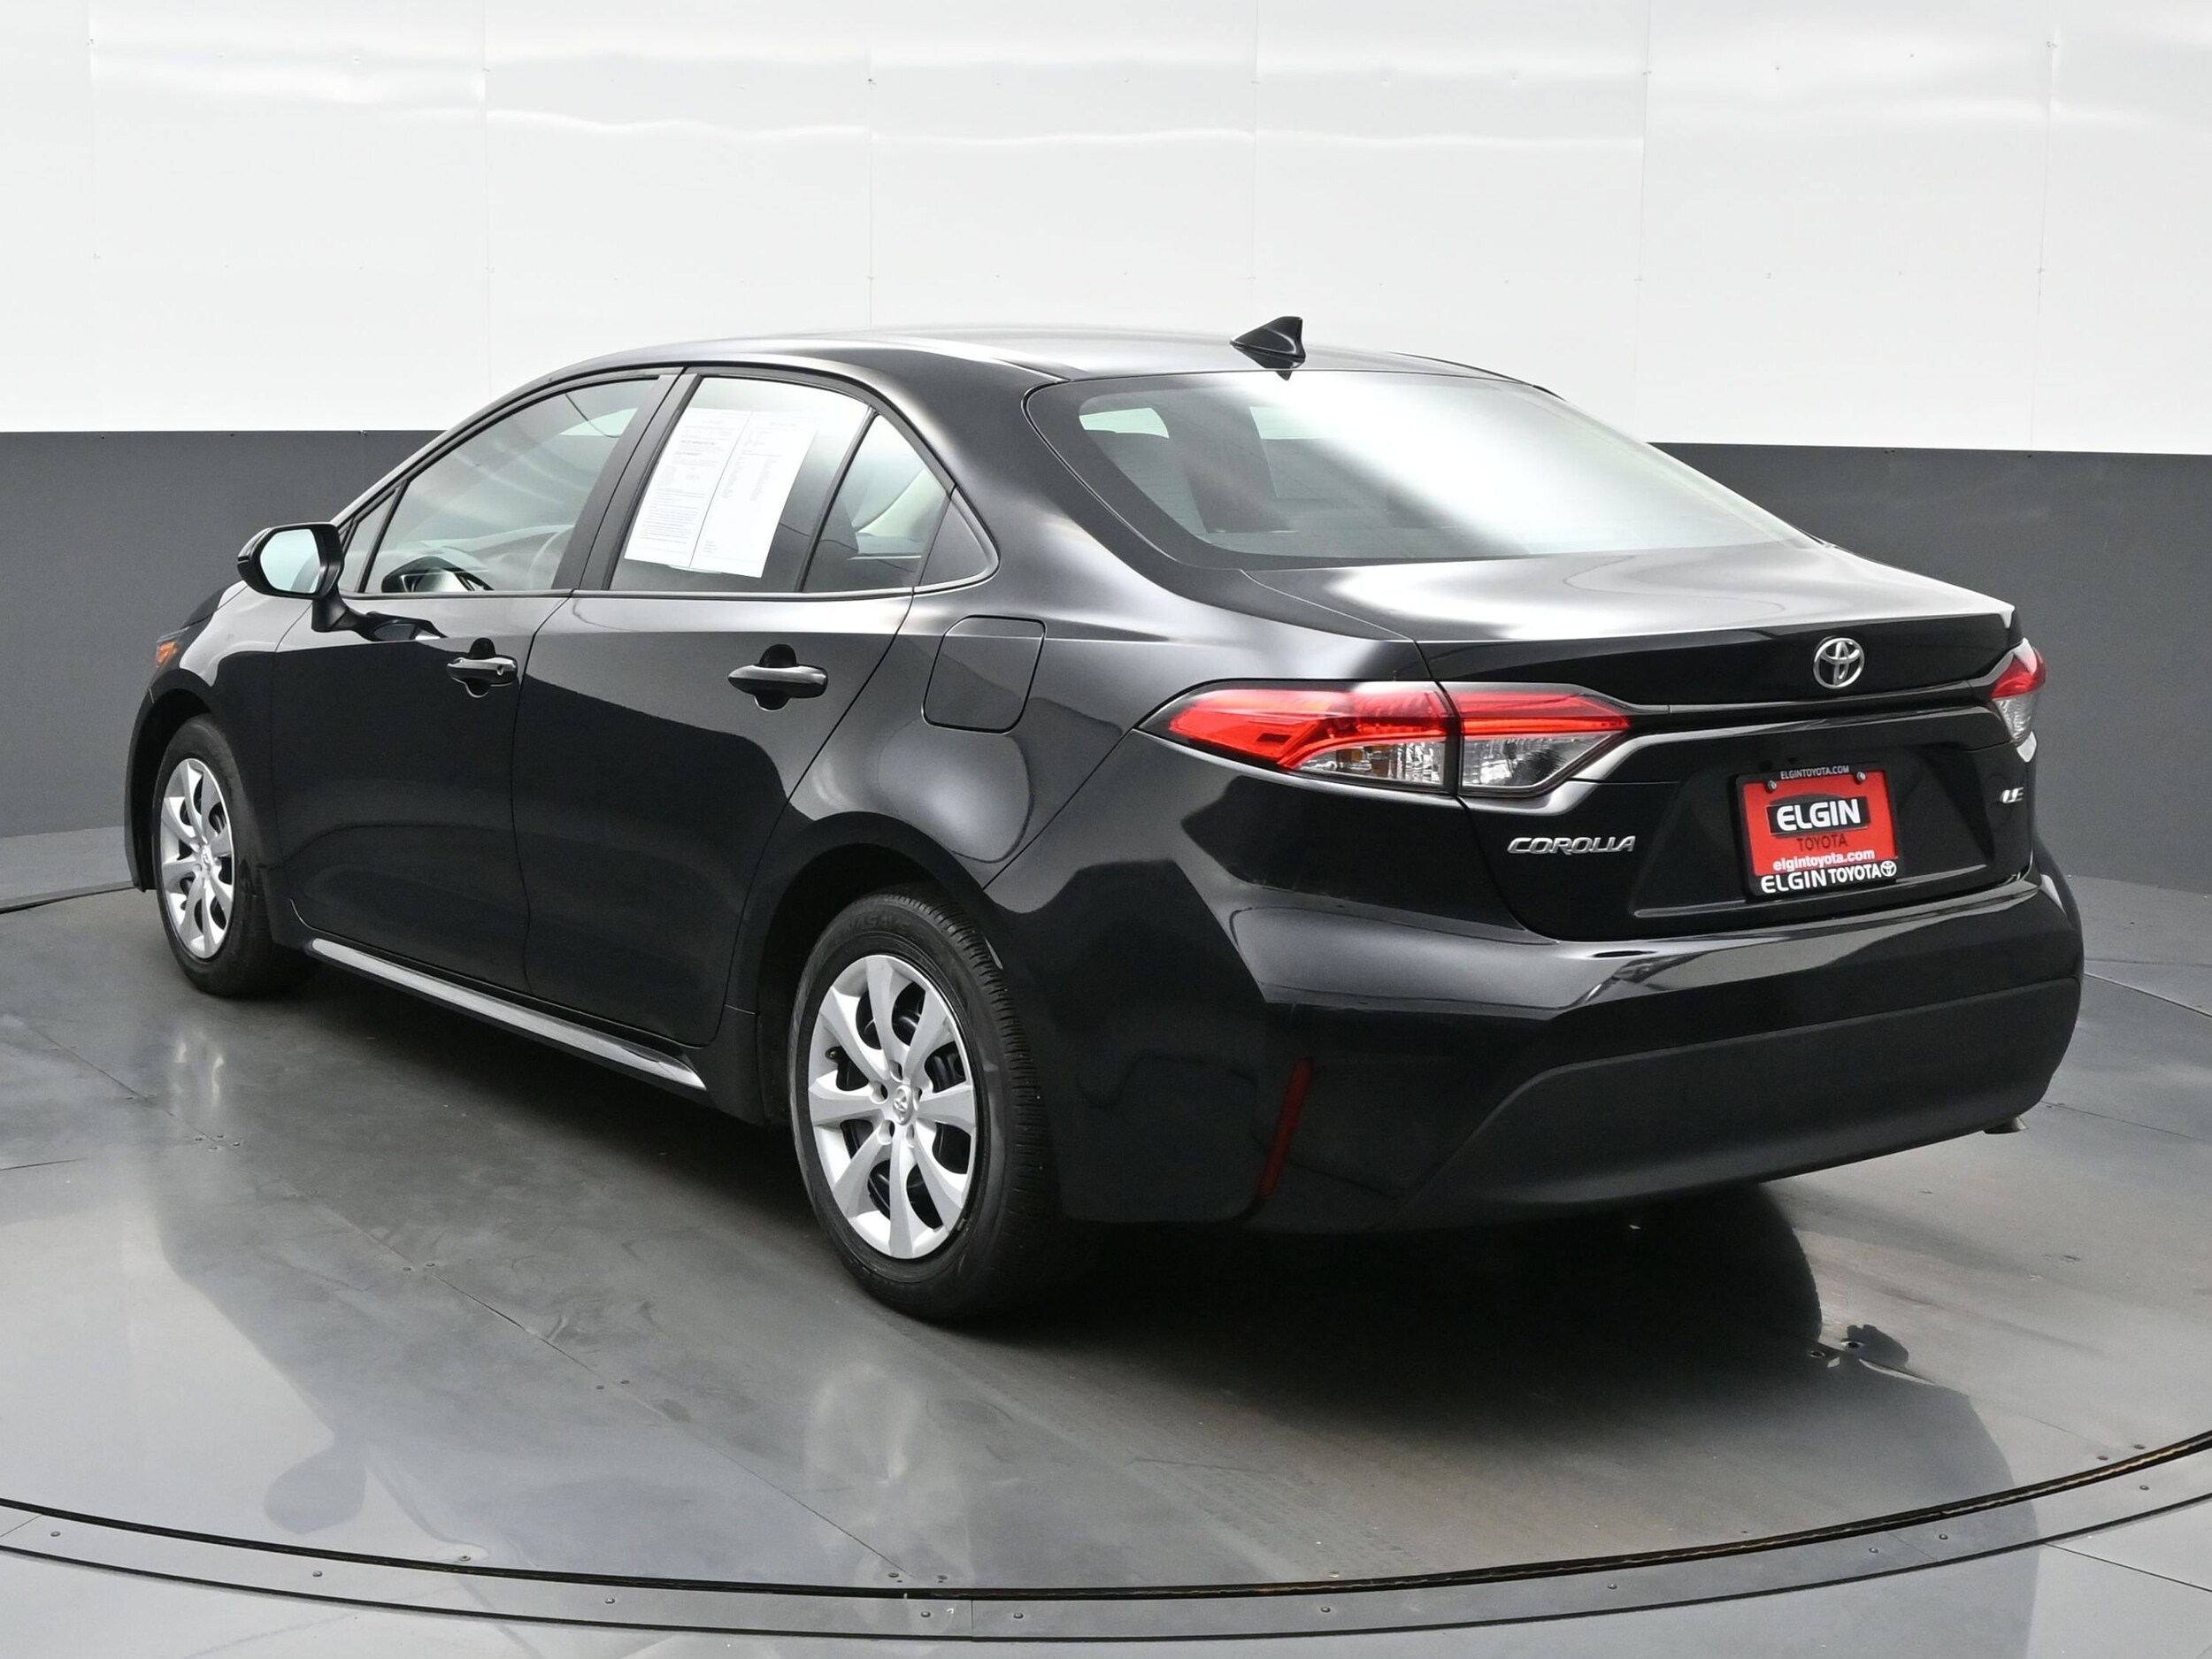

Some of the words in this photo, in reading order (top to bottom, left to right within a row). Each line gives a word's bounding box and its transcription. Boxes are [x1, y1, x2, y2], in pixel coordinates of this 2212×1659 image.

[1780, 765, 1849, 780] ELGINTOYOTA.COM
[1777, 799, 1861, 831] ELGIN
[1507, 835, 1636, 856] COROLLA
[1797, 833, 1848, 851] TOYOTA
[1772, 849, 1875, 872] elgintoyota.com
[1761, 870, 1827, 894] ELGIN
[1828, 863, 1882, 884] TOYOTA
